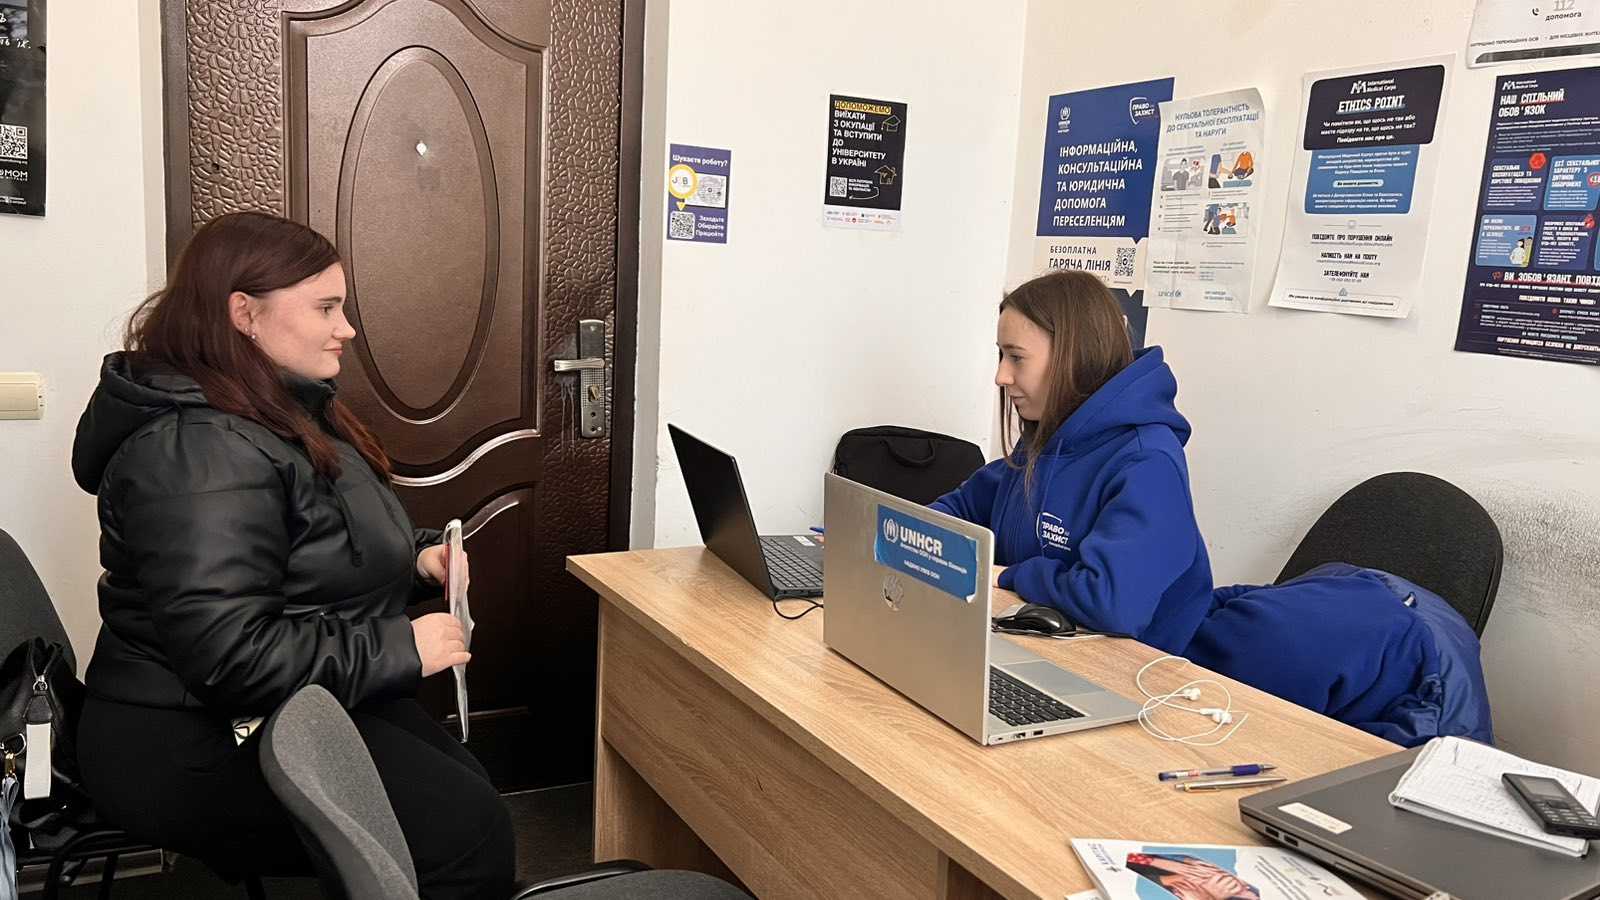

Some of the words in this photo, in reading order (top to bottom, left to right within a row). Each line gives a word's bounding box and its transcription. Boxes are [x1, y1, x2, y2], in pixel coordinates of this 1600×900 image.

[1545, 12, 1582, 21] допомога
[1338, 99, 1372, 112] ETHICS
[1374, 95, 1405, 108] POINT
[1500, 94, 1518, 106] НАШ
[1520, 88, 1565, 104] СПІЛЬНИЙ
[835, 101, 890, 114] ДОПОМОЖЕМО
[1202, 104, 1249, 117] ТОЛЕРАНТНІСТЬ
[1498, 104, 1546, 117] ОБОВ'ЯЗОК
[834, 110, 866, 120] ВИЇХАТИ
[840, 120, 875, 131] ОКУПАЦІЇ
[1167, 124, 1175, 133] ДО
[1202, 128, 1226, 136] НАРУГИ
[834, 129, 842, 137] ТА
[844, 130, 882, 141] ВСТУПИТИ
[832, 138, 843, 147] ДО
[1060, 138, 1138, 157] ІНФОРМАЦІЙНА,
[672, 154, 701, 164] Шукаєте
[702, 158, 728, 167] роботу?
[832, 148, 886, 160] УНІВЕРСИТЕТУ
[839, 158, 867, 167] УКРАЇНІ
[1058, 156, 1143, 175] КОНСУЛЬТАЦІЙНА
[1056, 181, 1067, 192] ТА
[1069, 178, 1125, 193] ЮРИДИЧНА
[1054, 197, 1106, 212] ДОПОМОГА
[1053, 215, 1126, 229] ПЕРЕСЕЛЕНЦЯМ
[1050, 246, 1097, 255] БЕЗОПЛАТНА
[1049, 258, 1082, 270] ГАРЯЧА
[1085, 259, 1111, 271] ЛІНІЯ
[1504, 272, 1515, 281] ВИ
[1518, 272, 1572, 284] ЗОБОВ'ЯЗАНІ
[900, 526, 942, 557] UNHCR
[1042, 531, 1068, 544] ЗАХИСТ
